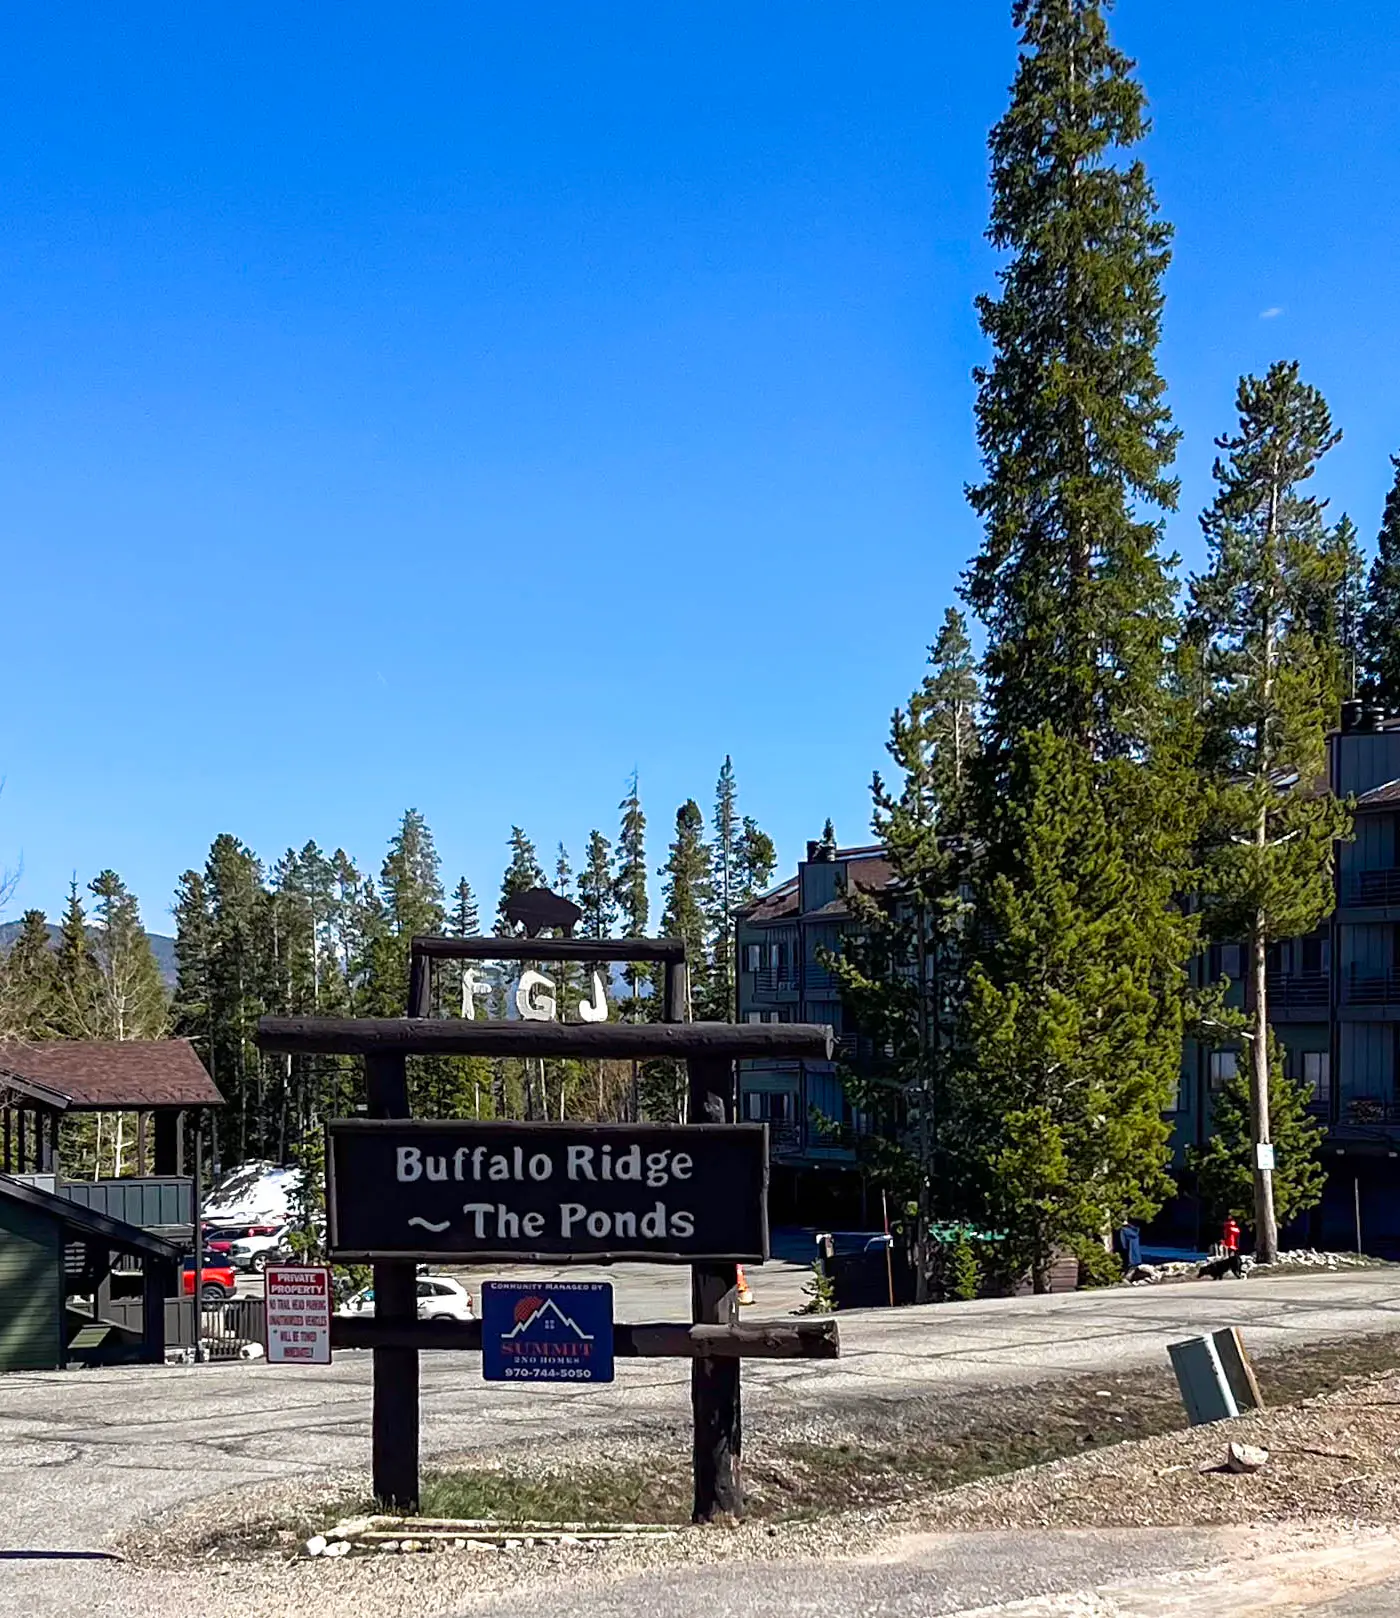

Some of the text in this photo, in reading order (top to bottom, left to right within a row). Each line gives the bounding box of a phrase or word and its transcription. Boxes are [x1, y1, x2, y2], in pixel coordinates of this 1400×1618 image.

[462, 968, 608, 1022] F G J
[397, 1145, 692, 1187] Buffalo Ridge
[463, 1203, 545, 1239] The
[559, 1202, 695, 1238] Ponds
[277, 1273, 316, 1283] PRIVATE
[270, 1285, 323, 1294] PROPERTY
[490, 1282, 543, 1290] COMMUNITY
[501, 1341, 593, 1356] SUMMIT
[540, 1356, 580, 1364] HOMES
[504, 1368, 592, 1378] 970-744-5050
